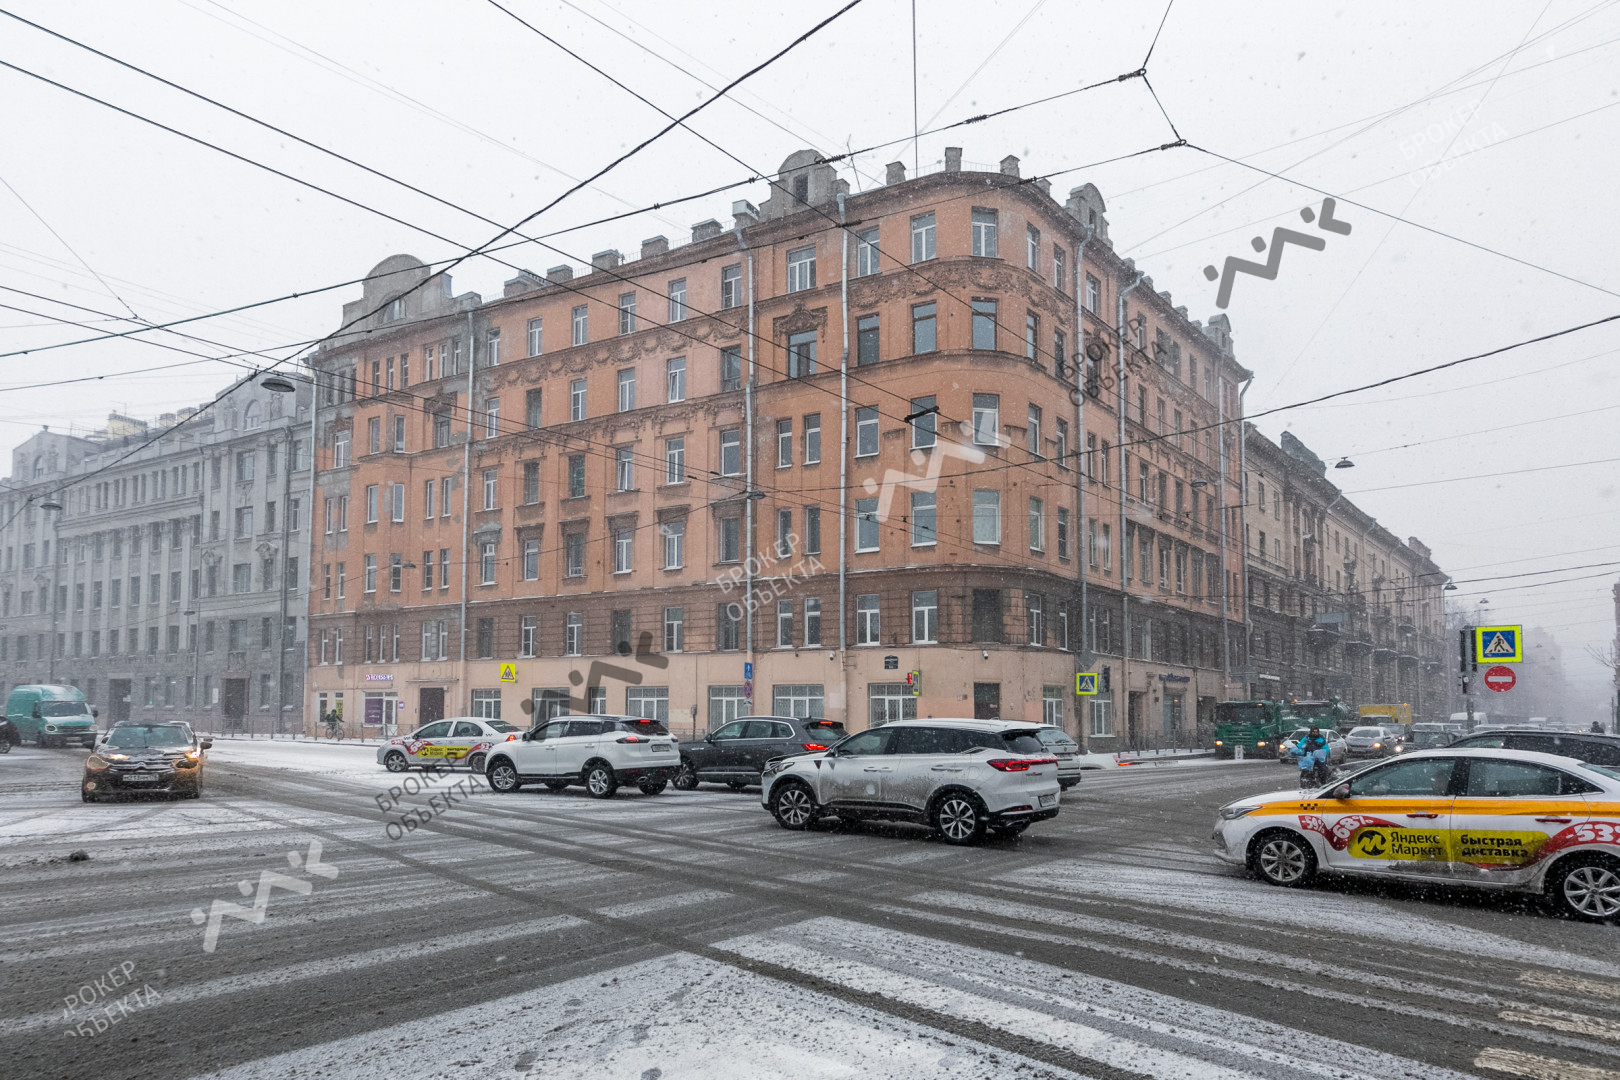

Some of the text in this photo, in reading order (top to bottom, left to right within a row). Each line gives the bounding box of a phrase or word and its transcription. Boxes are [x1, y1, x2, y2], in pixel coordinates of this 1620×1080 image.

[1302, 816, 1326, 834] -59%
[1333, 815, 1375, 842] -68%
[1391, 832, 1441, 845] Яндекс
[1460, 834, 1522, 847] быстрая
[1391, 843, 1443, 856] Маркет
[1461, 847, 1529, 858] доставка
